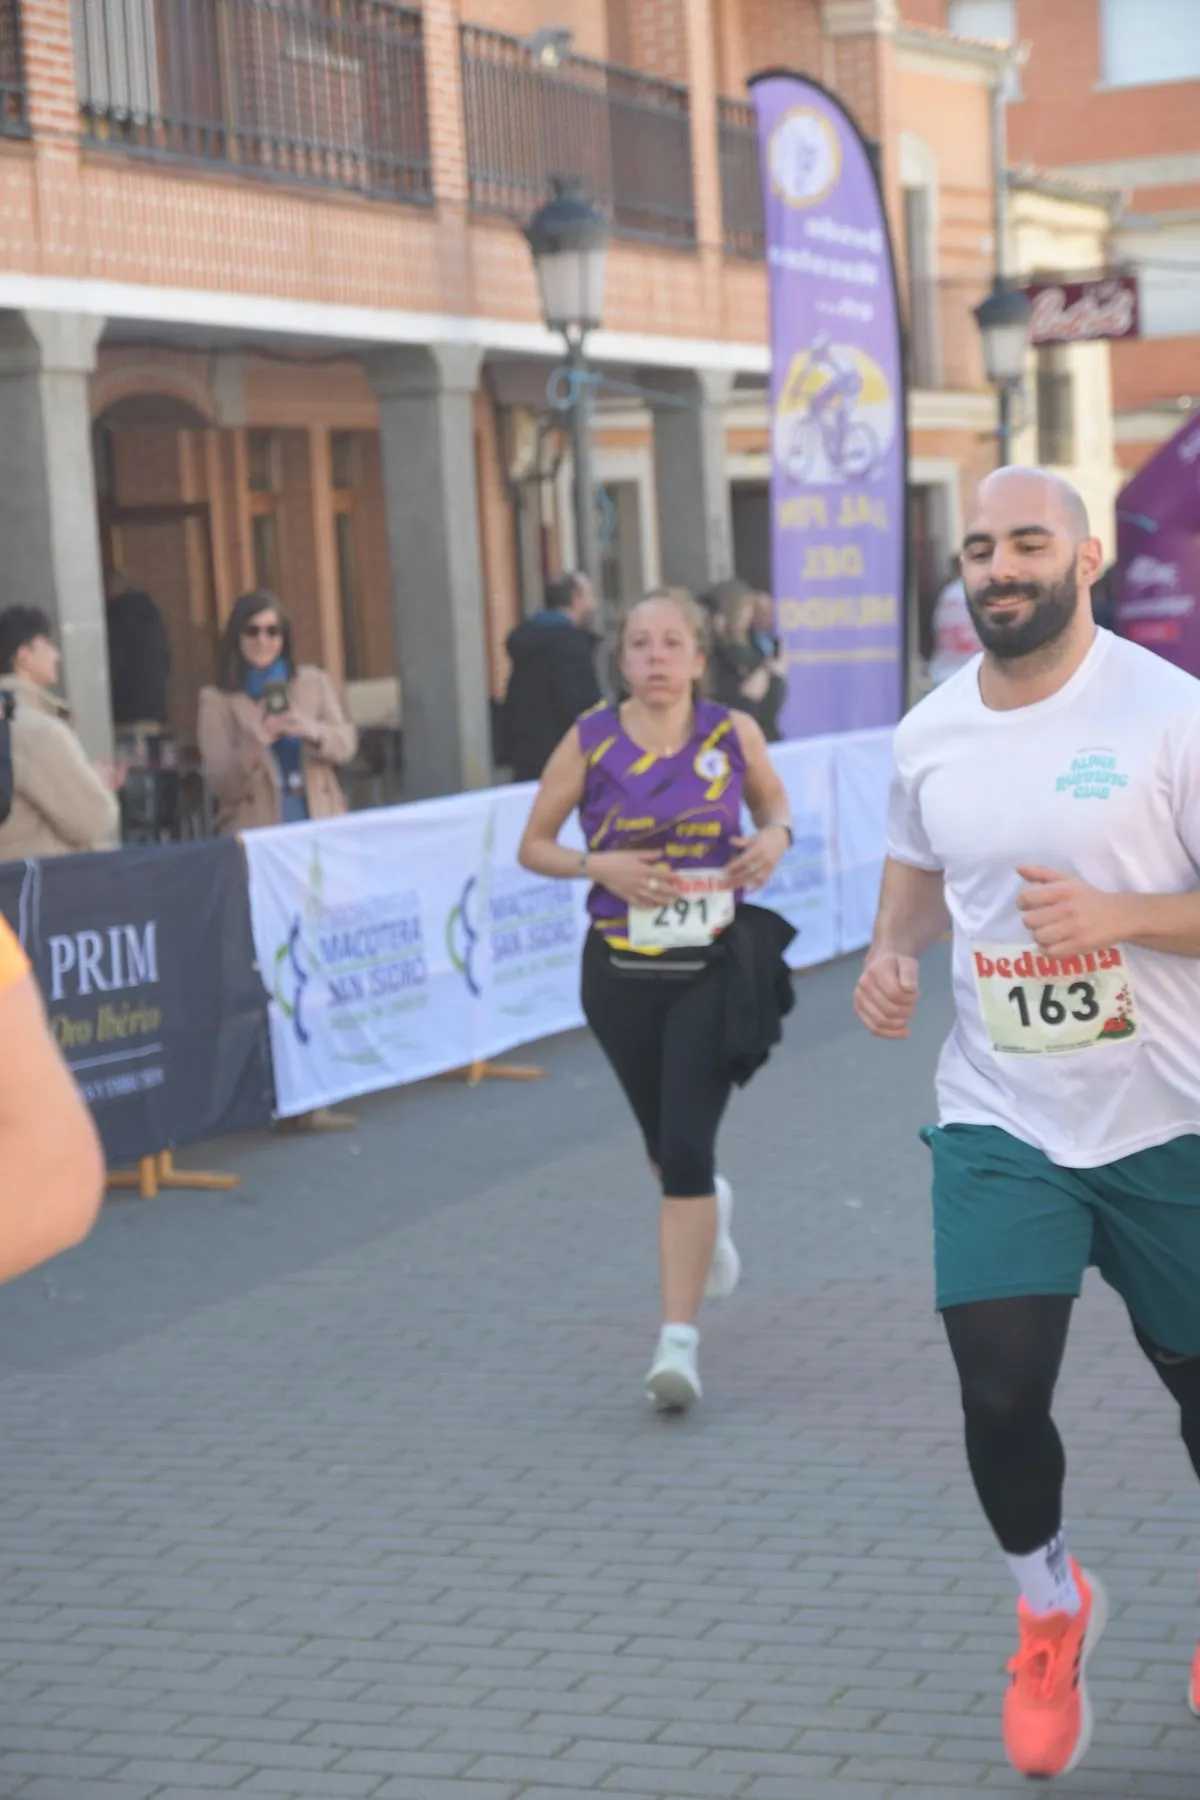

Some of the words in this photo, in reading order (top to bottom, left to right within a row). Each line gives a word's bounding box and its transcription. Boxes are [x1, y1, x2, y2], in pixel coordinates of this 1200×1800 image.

[653, 896, 708, 927] 291
[47, 919, 160, 1001] PRIM
[1008, 981, 1100, 1027] 163
